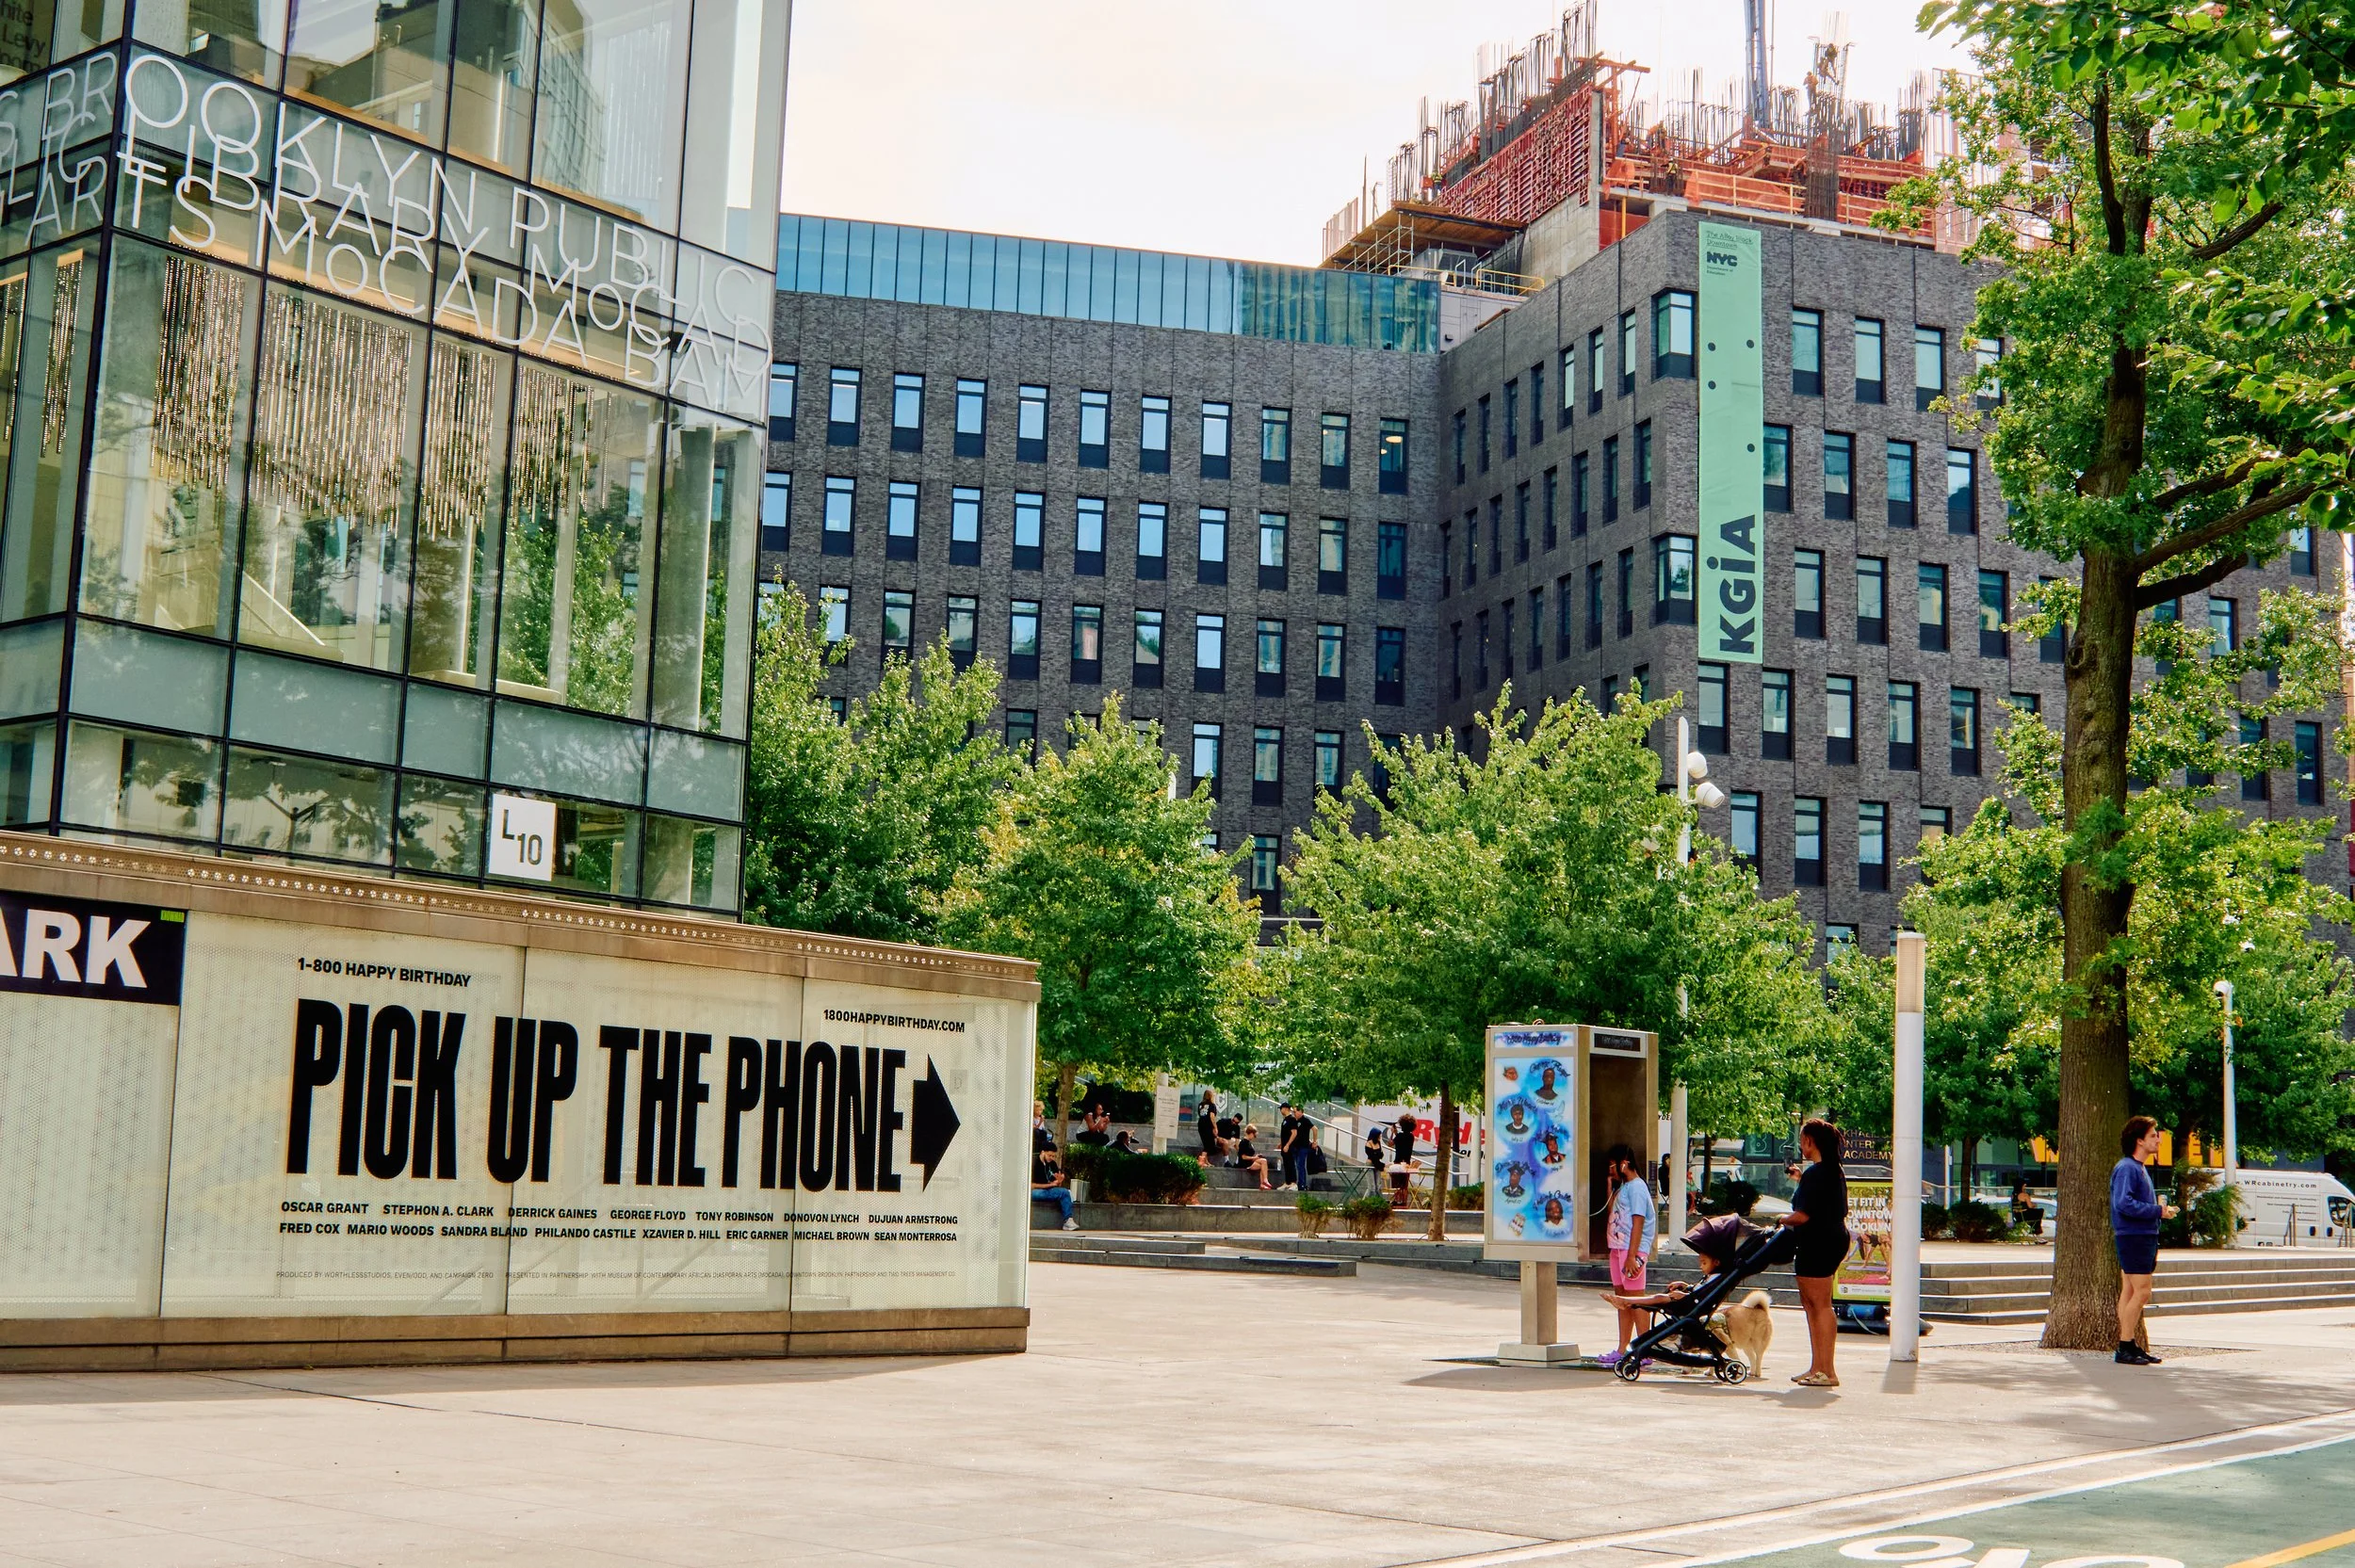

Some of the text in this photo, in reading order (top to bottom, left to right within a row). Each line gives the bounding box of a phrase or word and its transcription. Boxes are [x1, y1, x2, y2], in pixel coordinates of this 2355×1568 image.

[41, 52, 477, 234] BROOKLYN
[510, 186, 755, 326] PUBLIC
[124, 105, 490, 283] LIBRARY
[1706, 251, 1738, 267] NYC
[24, 152, 768, 423] ARTS MOCADA BAM
[298, 957, 472, 987] 1-800 HAPPY BIRTHDAY
[823, 1009, 966, 1033] 1800HAPPYBIRTHDAY.COM
[285, 998, 906, 1193] PICK UP THE PHONE
[1843, 1150, 1893, 1160] ACADEMY
[2224, 1179, 2317, 1188] w.WRcabinetry.com
[1860, 1197, 1874, 1207] FIT
[1876, 1198, 1886, 1207] IN
[281, 1202, 958, 1224] OSCAR GRANT STEPHON A. CLARK DERRICK GAINES GEORGE FLOYD TONY ROBINSON DONOVON LYNCH DUJUAN ARMSTRONG
[1846, 1209, 1893, 1220] OWNTOW
[280, 1222, 957, 1242] FRED COX MARIO WOODS SANDRA BLAND PHILANDO CASTILE XZAVIER D. HILL ERIC GARNER MICHAEL BROWN SEAN MONTERROSA
[1845, 1221, 1892, 1232] ROOKLYN
